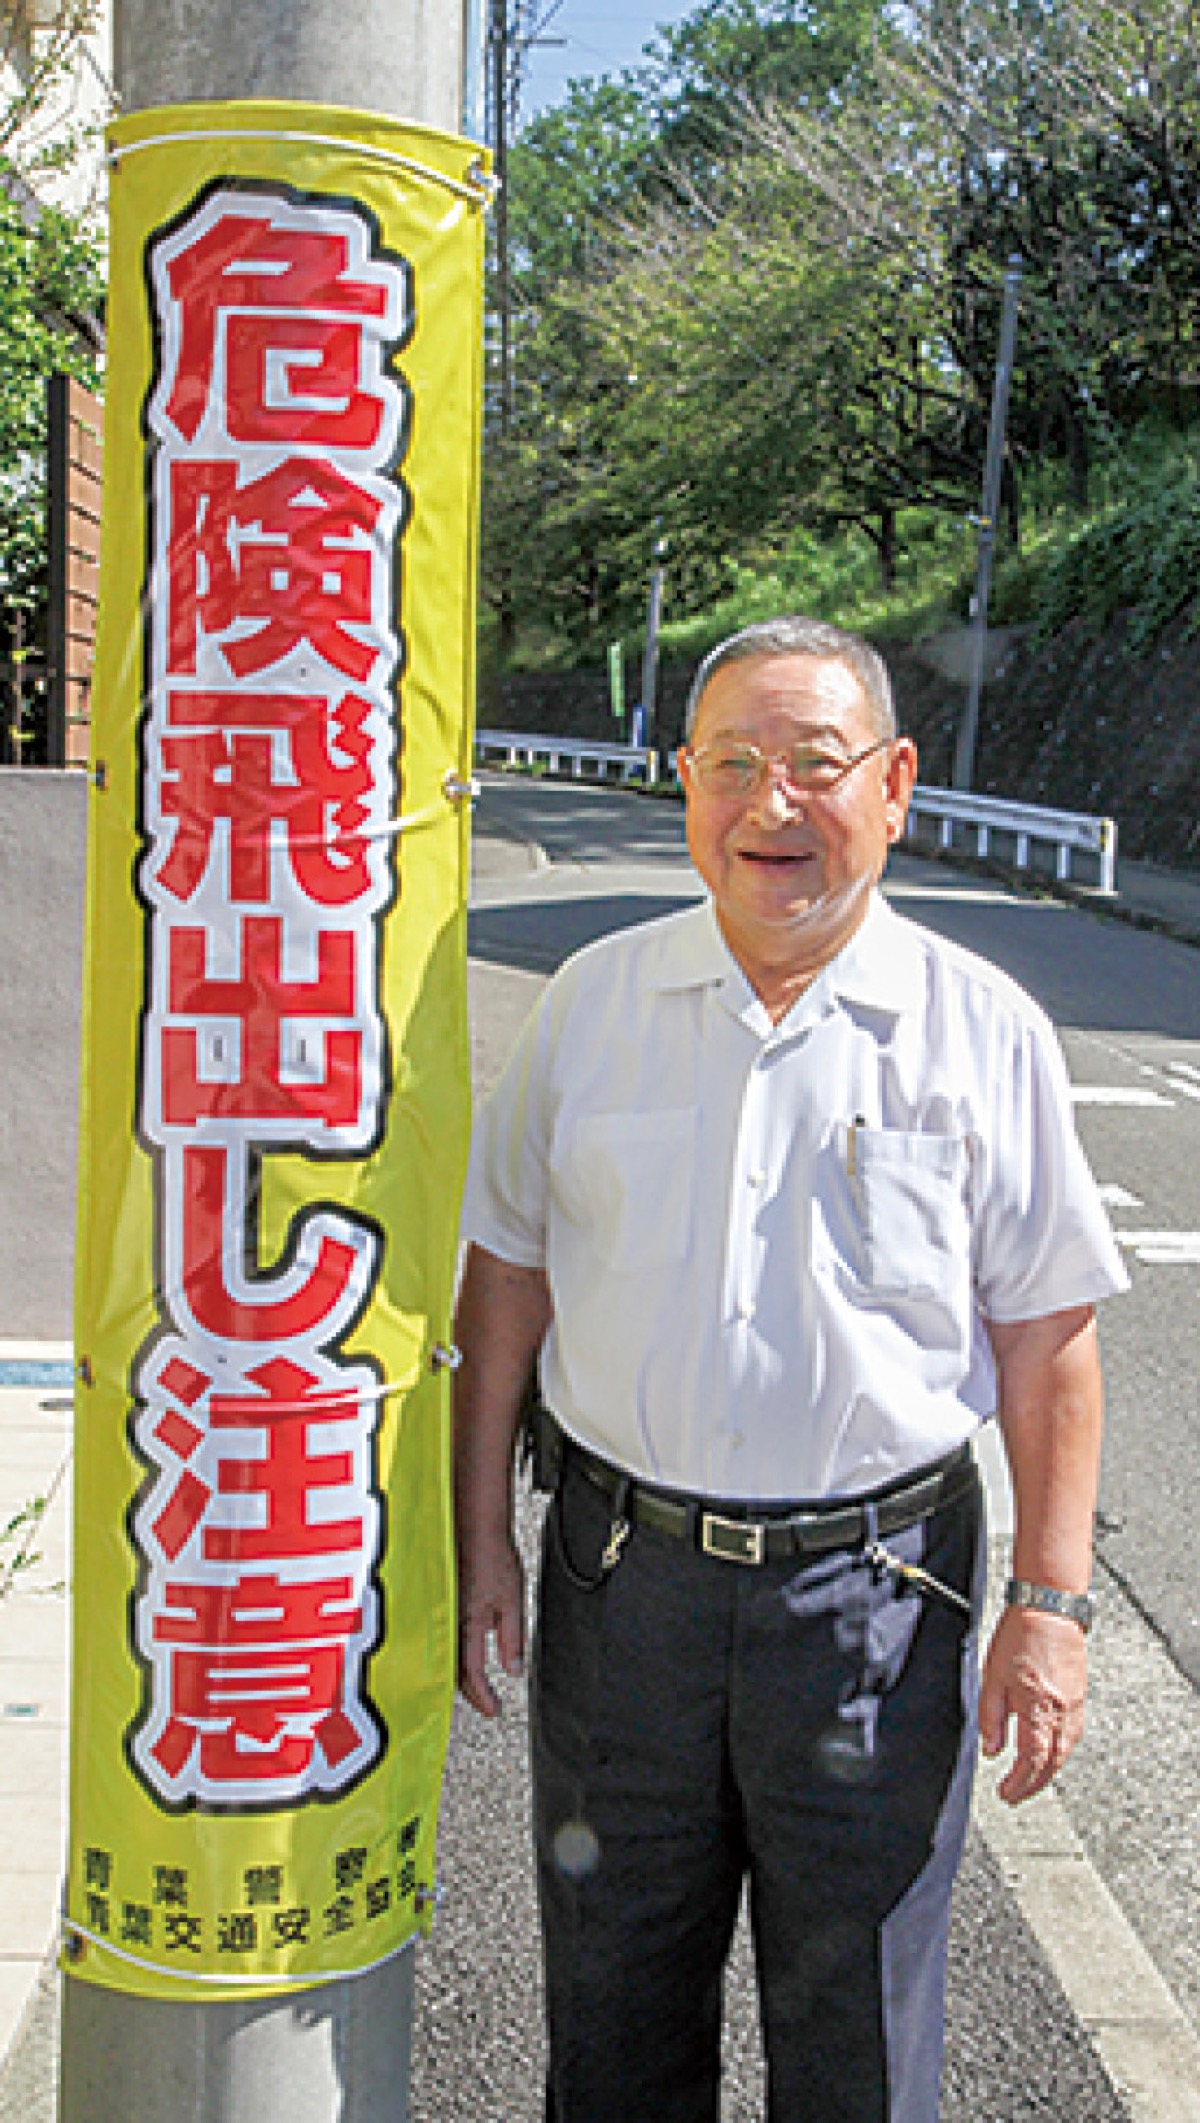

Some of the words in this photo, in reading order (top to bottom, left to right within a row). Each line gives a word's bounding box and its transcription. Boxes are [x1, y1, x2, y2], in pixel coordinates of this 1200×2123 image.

[152, 214, 388, 1780] 危険飛出し注意
